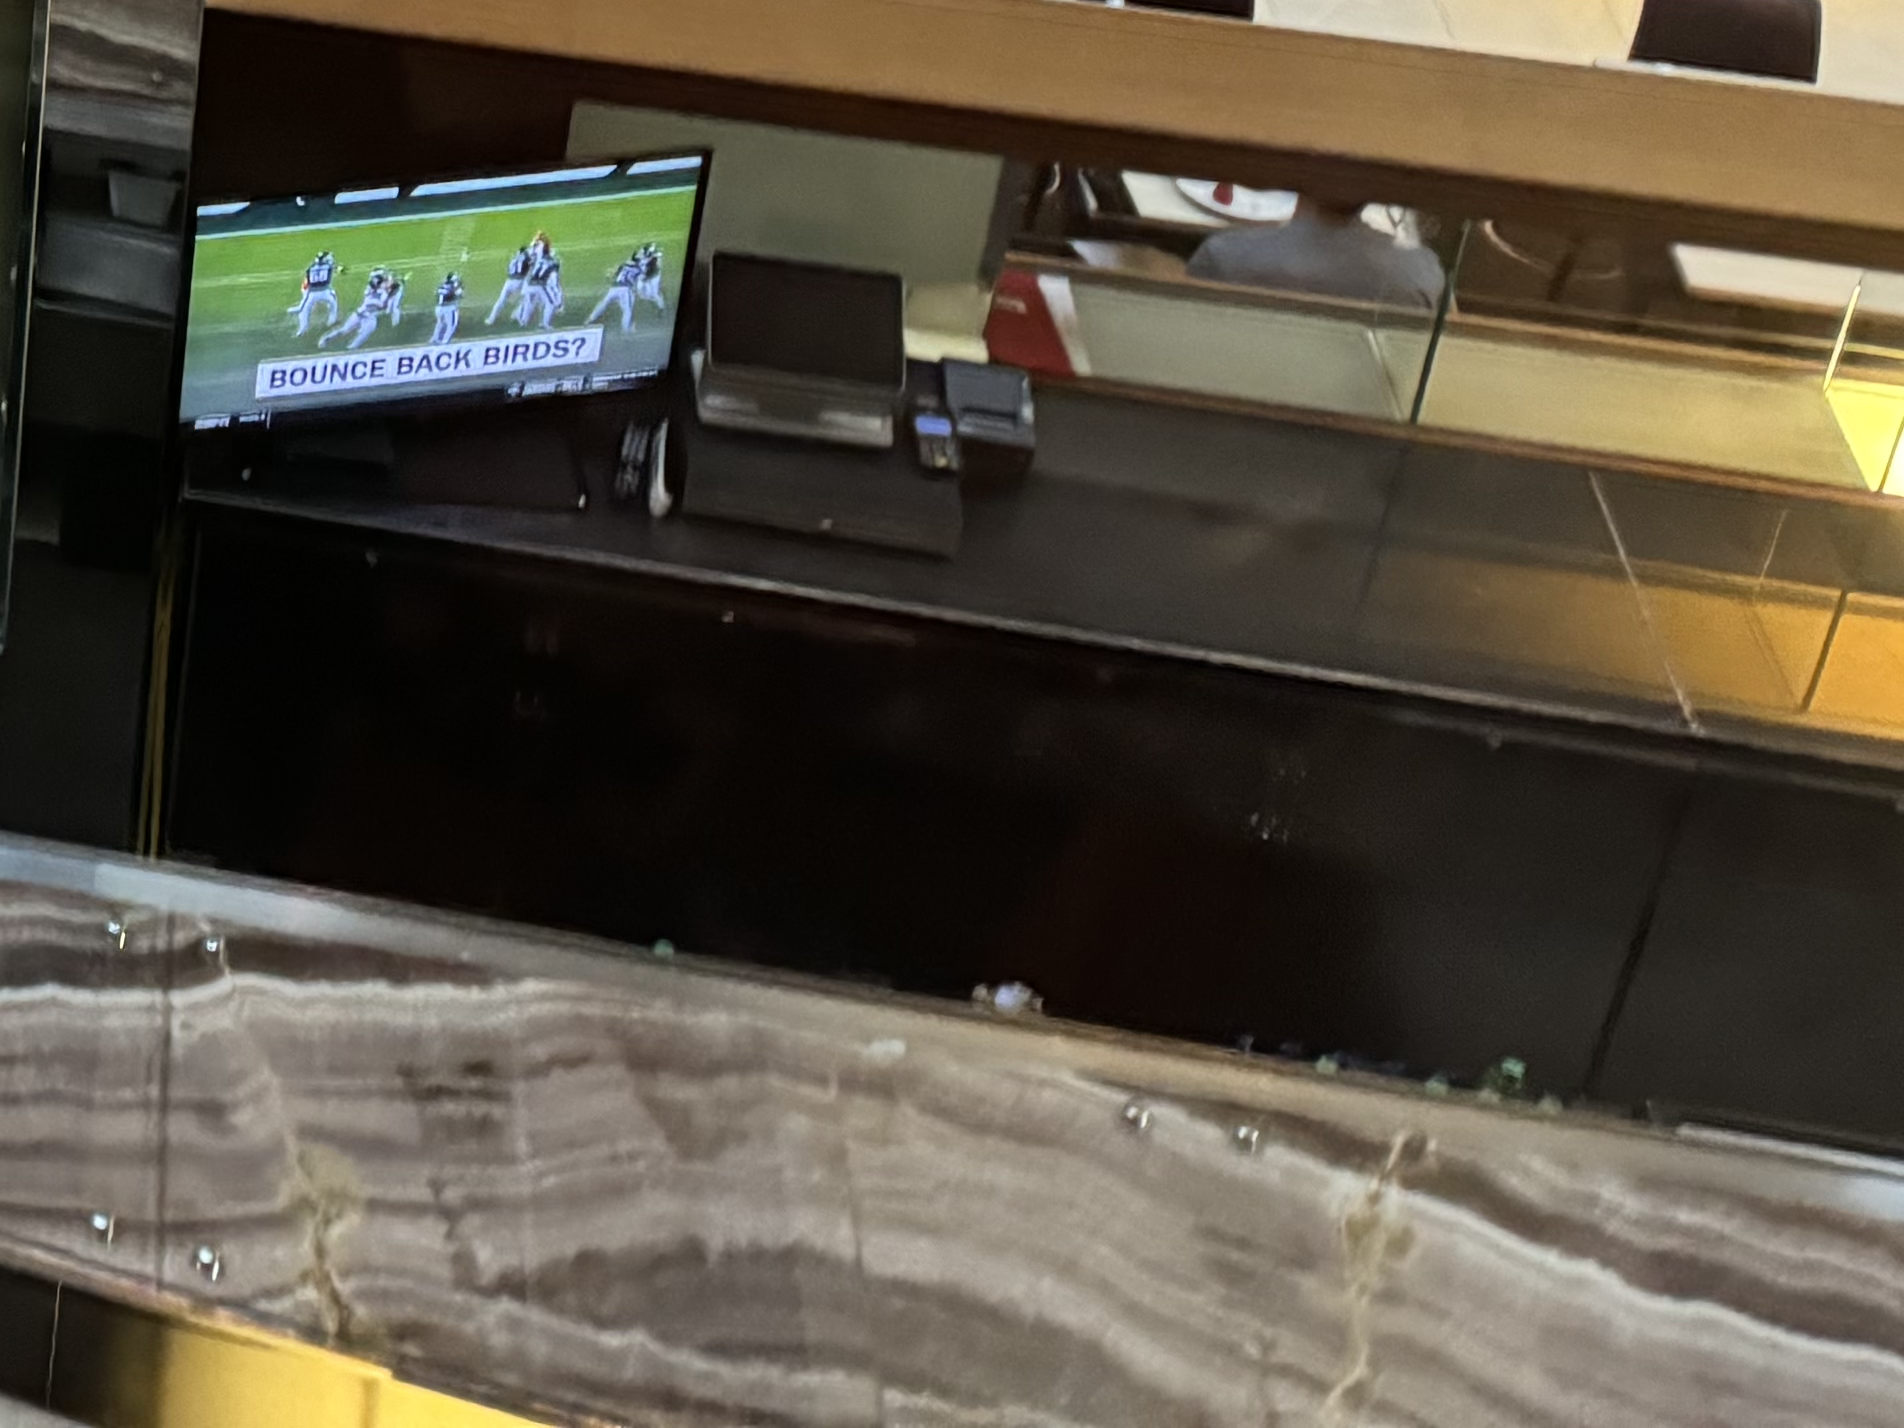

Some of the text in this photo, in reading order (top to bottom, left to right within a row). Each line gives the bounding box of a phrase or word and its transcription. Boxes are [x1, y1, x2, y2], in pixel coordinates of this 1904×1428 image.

[269, 337, 587, 390] BOUNCE BACK BIRDS?
